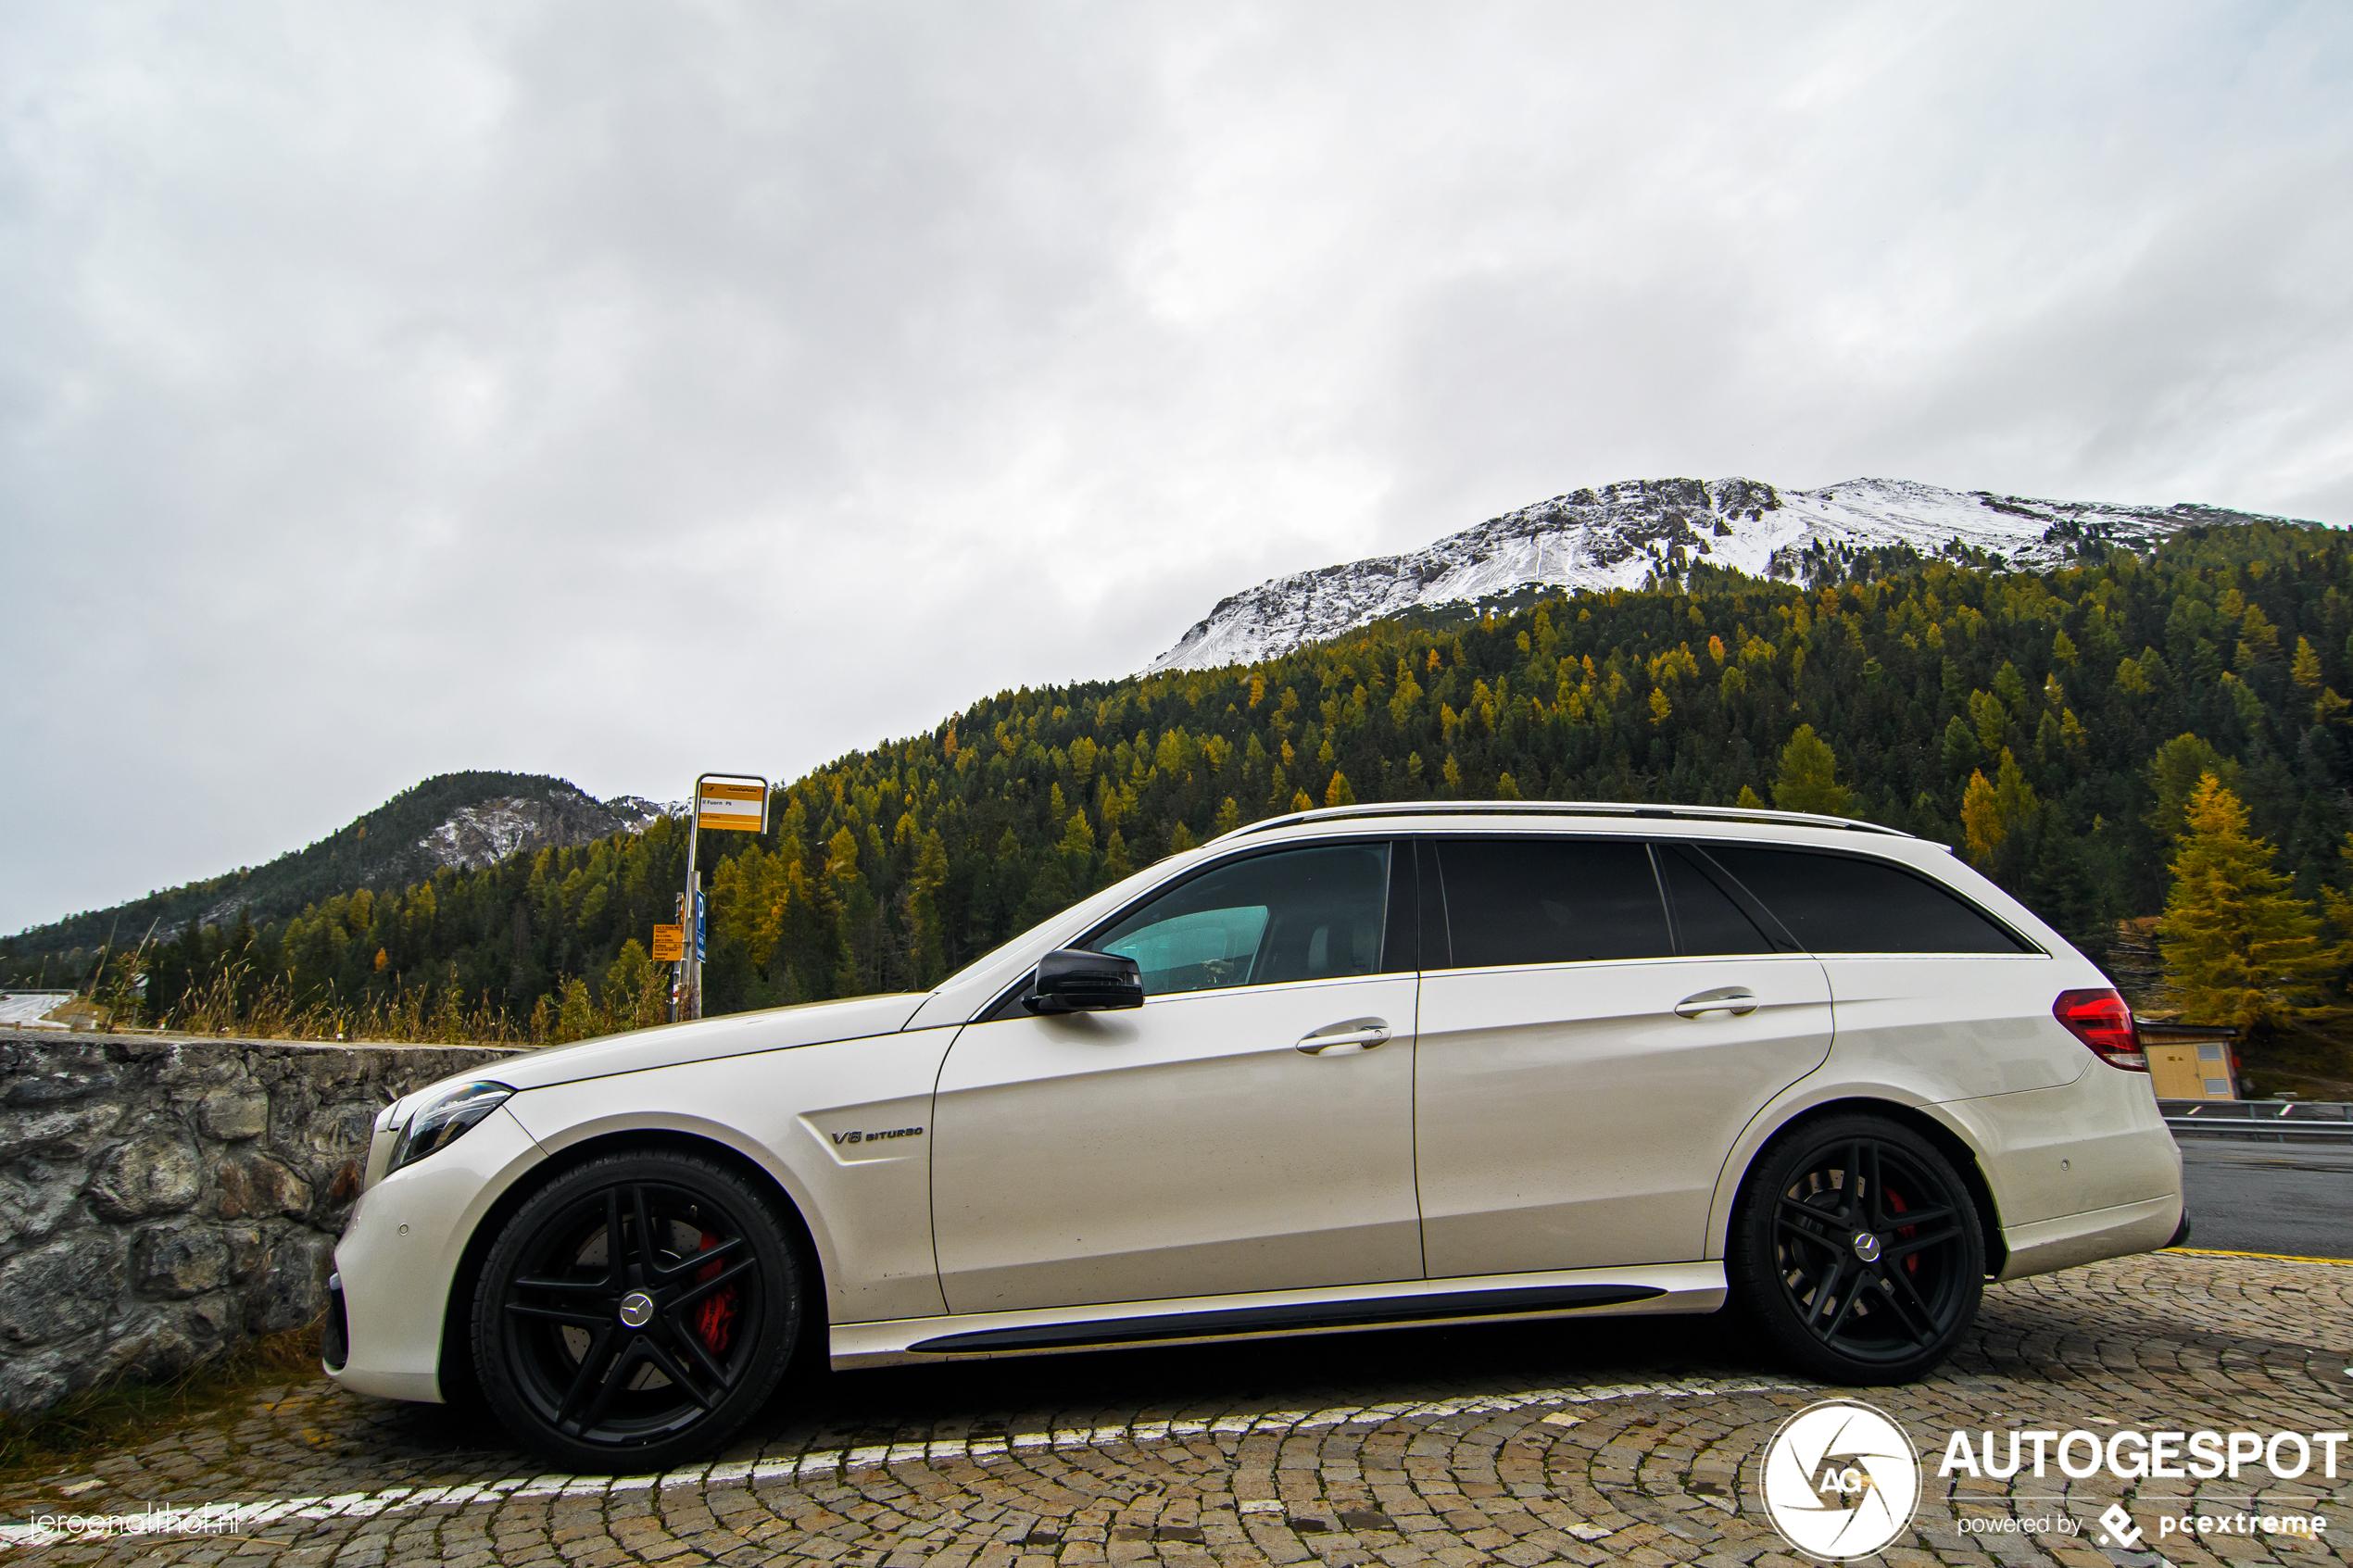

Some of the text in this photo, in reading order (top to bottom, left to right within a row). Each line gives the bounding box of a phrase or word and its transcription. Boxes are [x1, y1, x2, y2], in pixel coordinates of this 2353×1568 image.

[698, 896, 704, 930] P
[832, 1126, 924, 1144] V8 BITURBO
